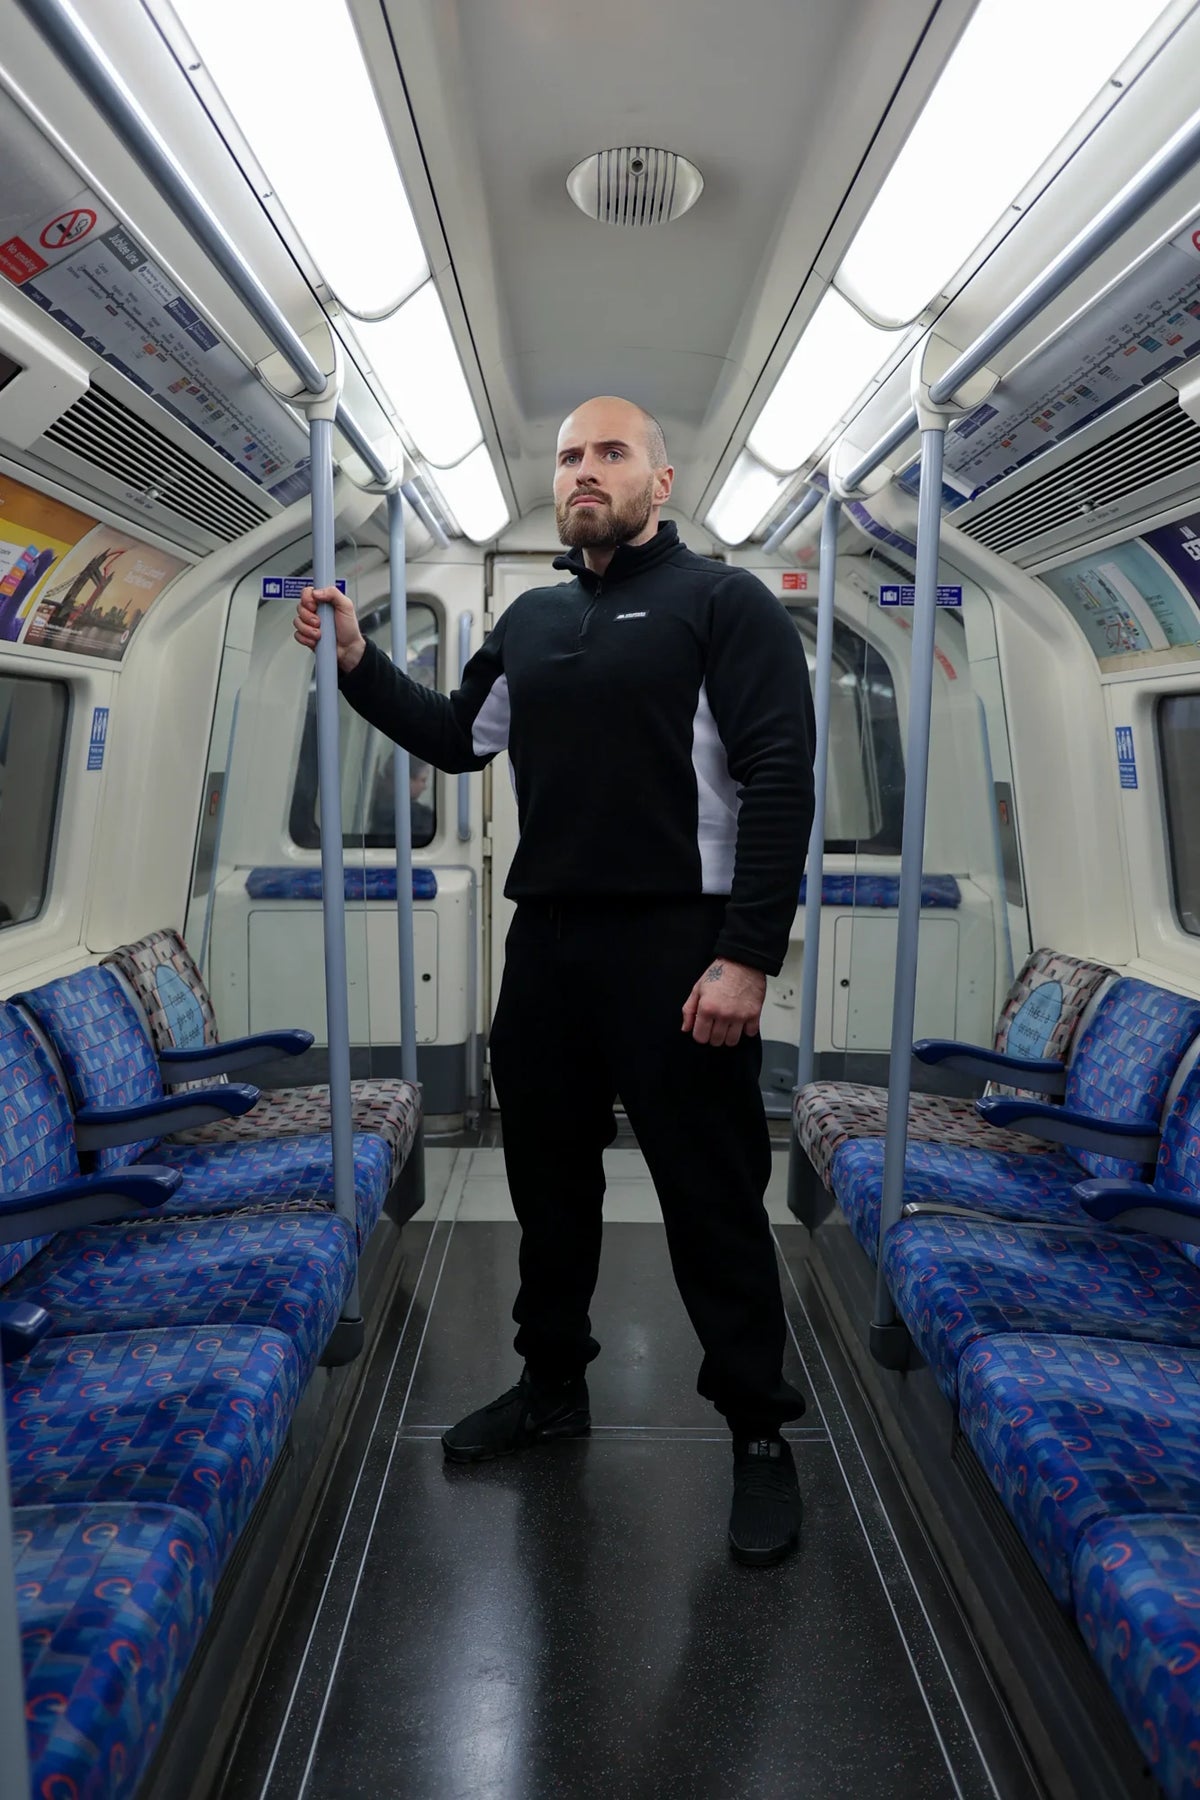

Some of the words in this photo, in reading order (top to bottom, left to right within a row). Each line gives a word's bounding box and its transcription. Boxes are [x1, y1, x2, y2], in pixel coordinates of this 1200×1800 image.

[6, 242, 18, 253] No
[14, 251, 39, 273] smoking
[108, 233, 131, 256] Jubilee
[125, 250, 140, 265] line
